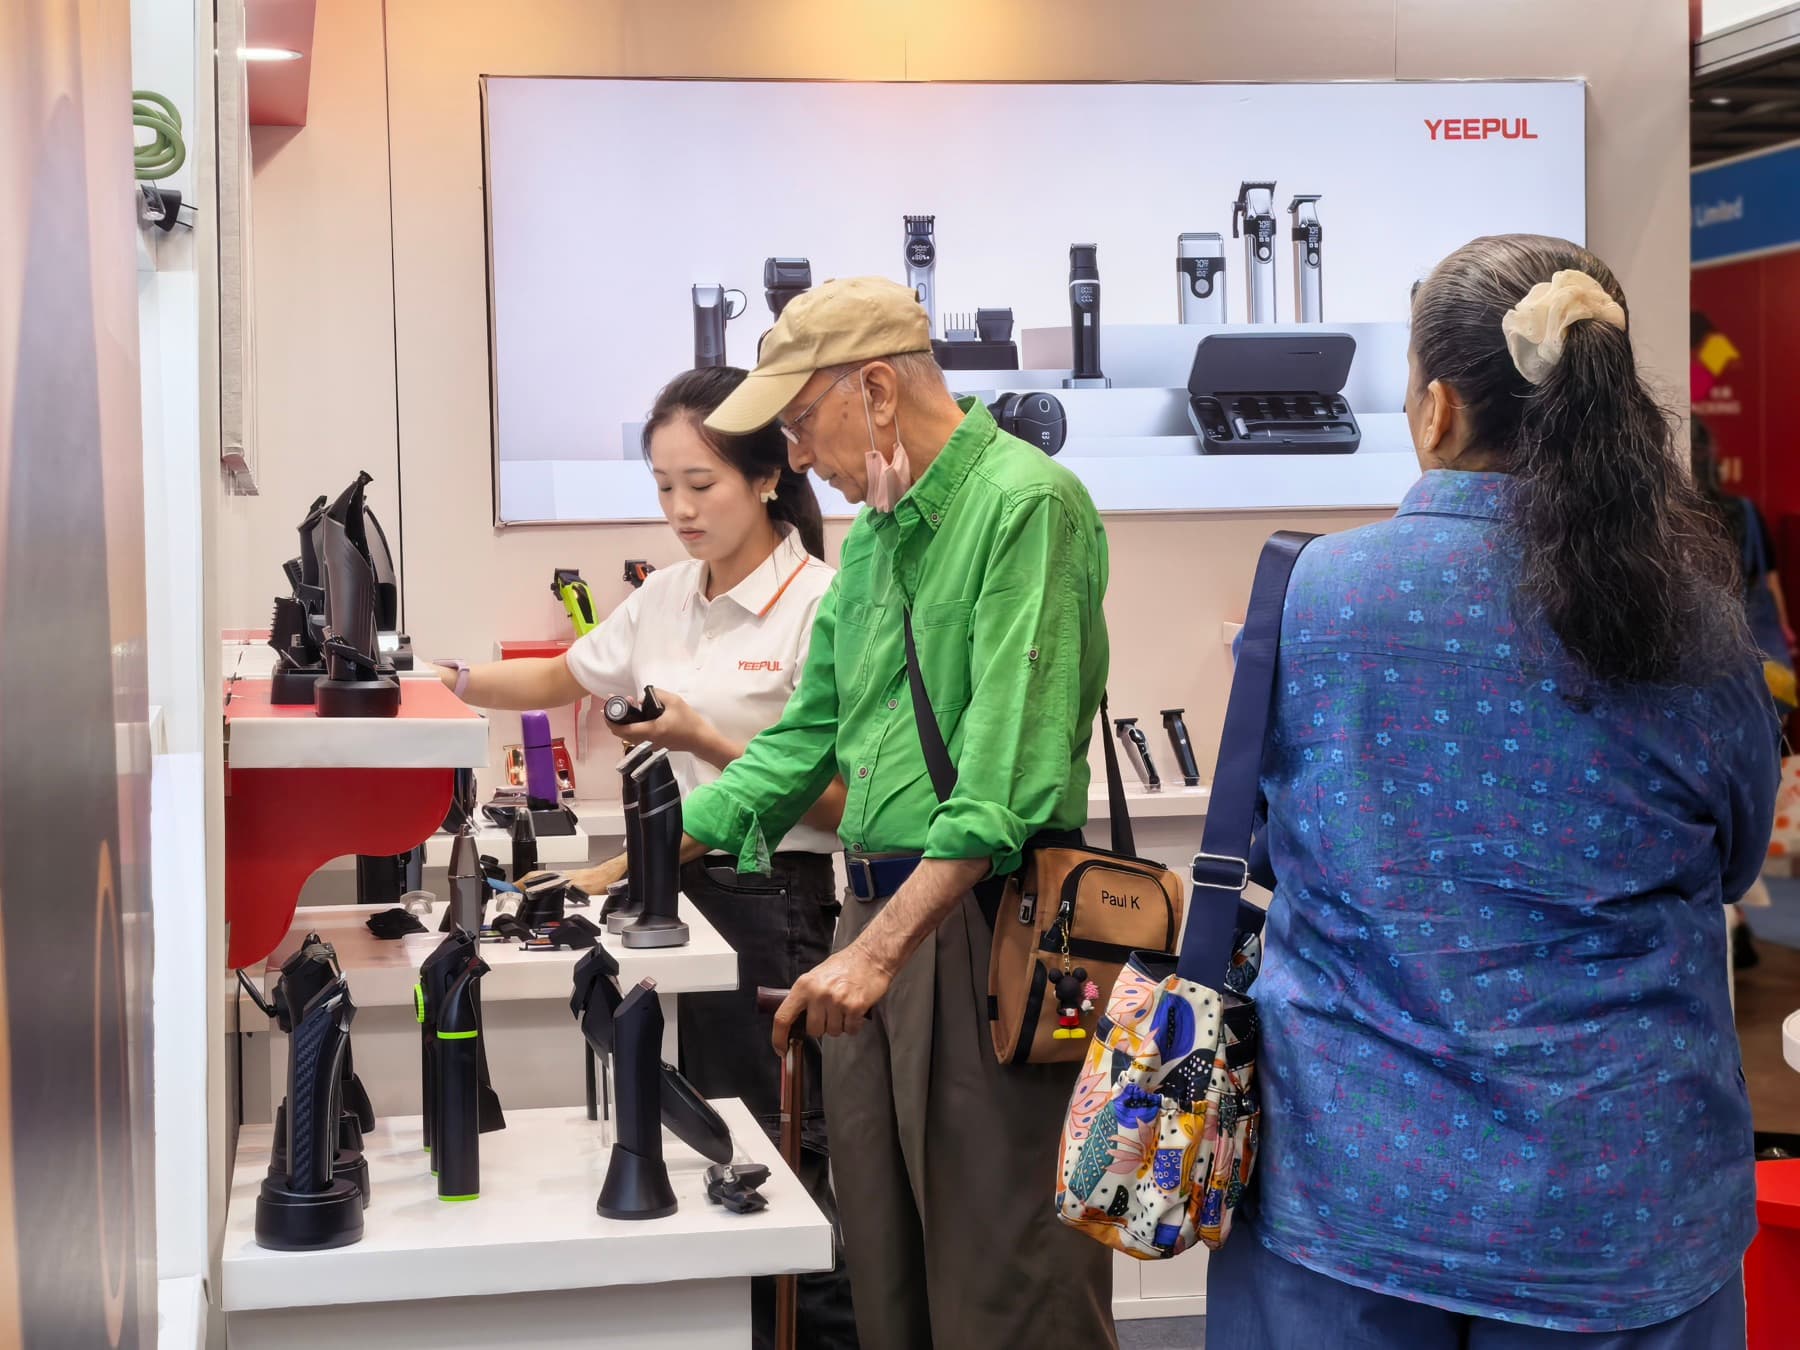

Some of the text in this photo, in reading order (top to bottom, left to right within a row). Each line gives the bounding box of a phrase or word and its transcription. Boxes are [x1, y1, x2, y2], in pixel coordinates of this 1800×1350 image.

[1424, 118, 1538, 140] YEEPUL
[1695, 196, 1743, 227] Limited
[738, 660, 783, 671] YEEPUL
[1101, 890, 1140, 910] Paul K
